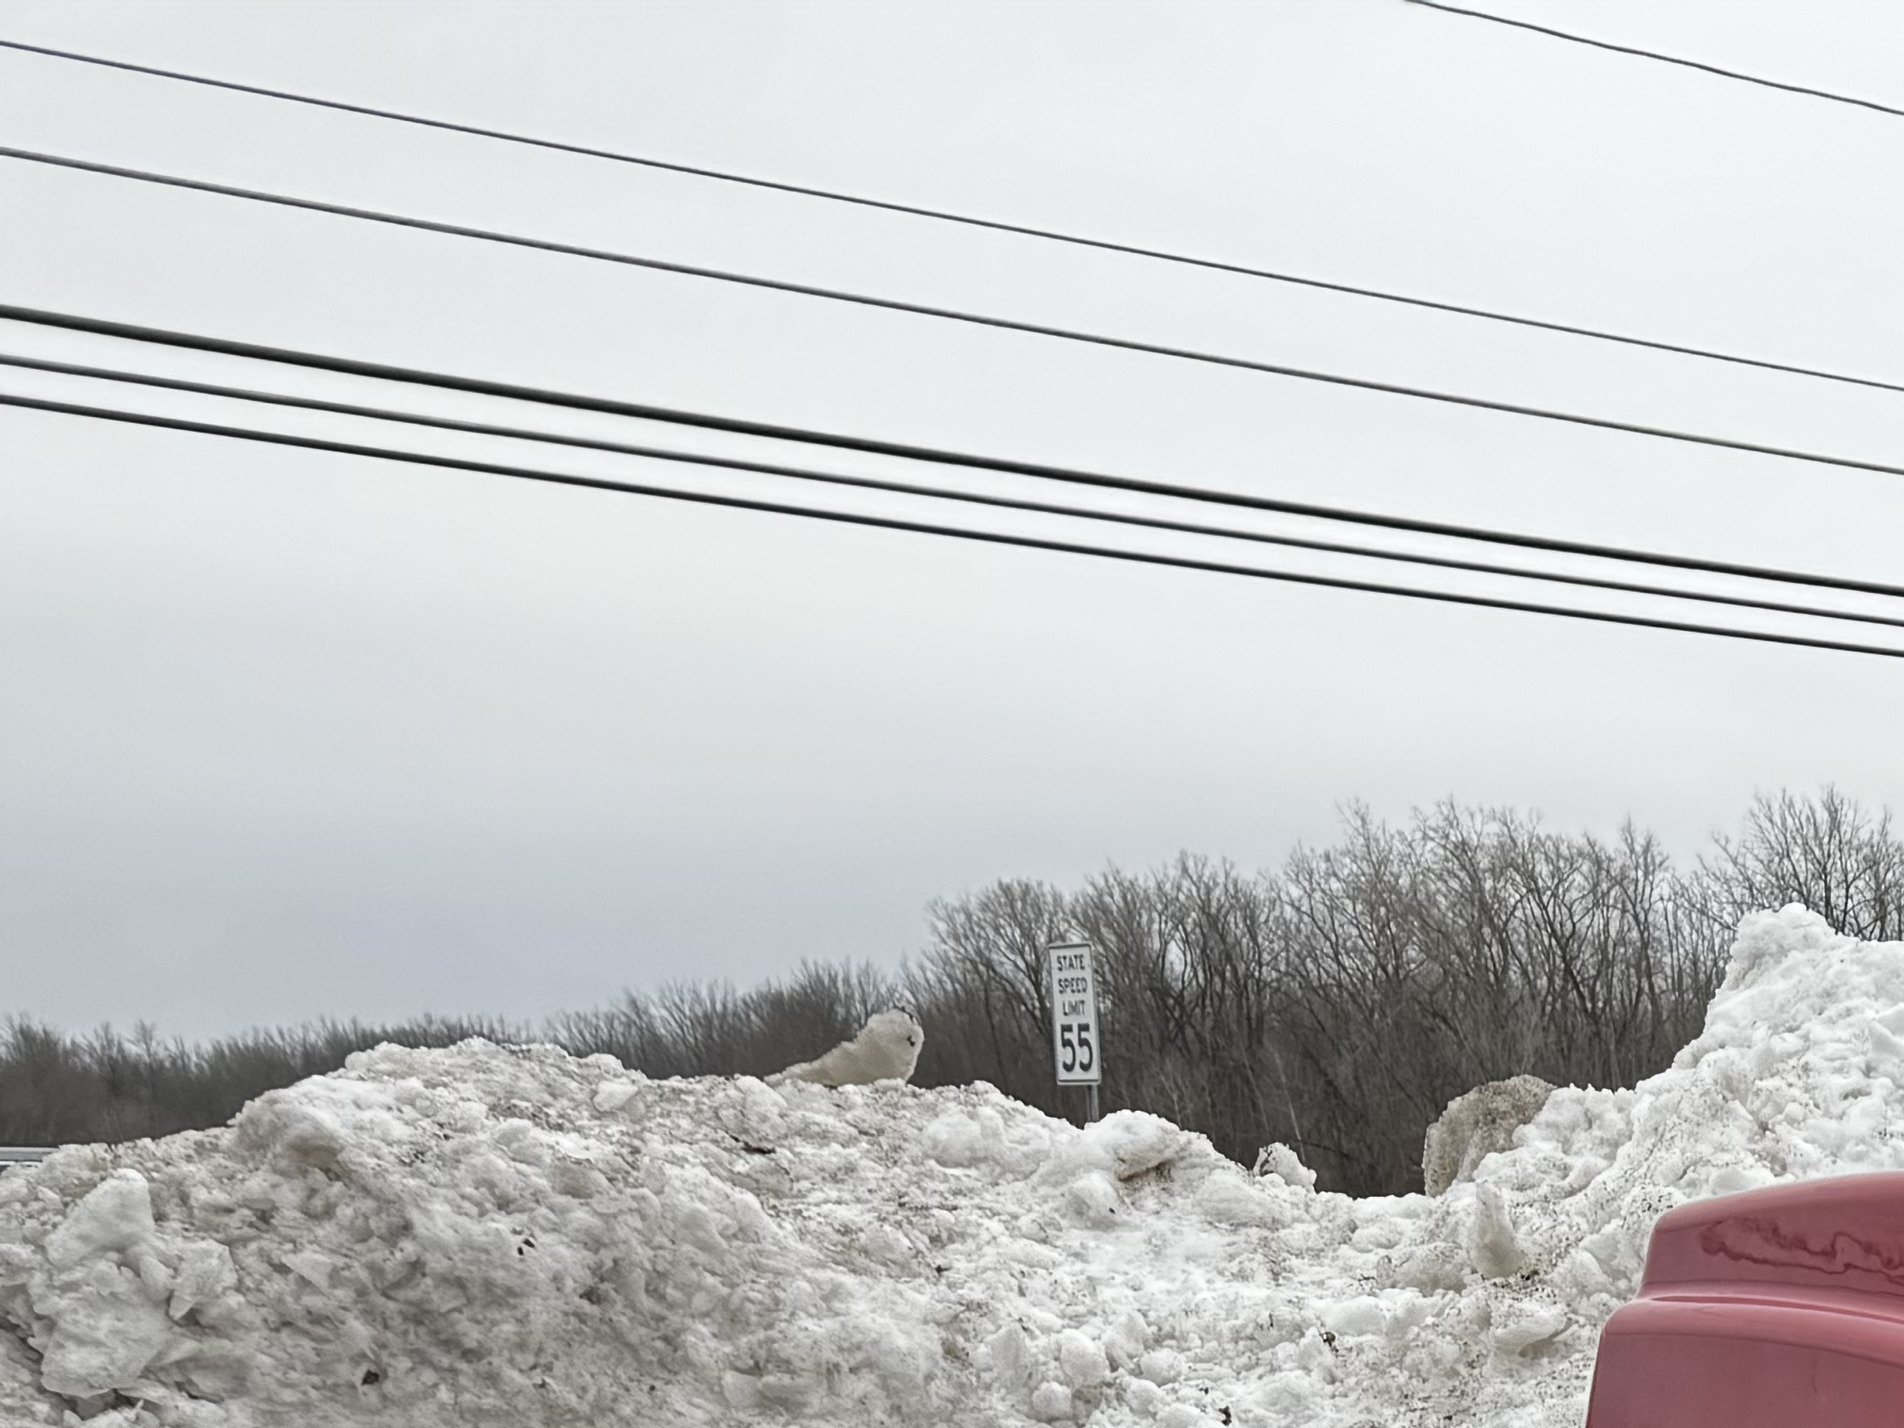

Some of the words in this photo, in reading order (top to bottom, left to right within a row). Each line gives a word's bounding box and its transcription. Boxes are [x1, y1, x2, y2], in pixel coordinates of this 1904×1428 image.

[1056, 954, 1086, 972] STATE
[1058, 977, 1088, 994] SPEED
[1062, 1000, 1086, 1016] LIMIT
[1061, 1022, 1093, 1073] 55
